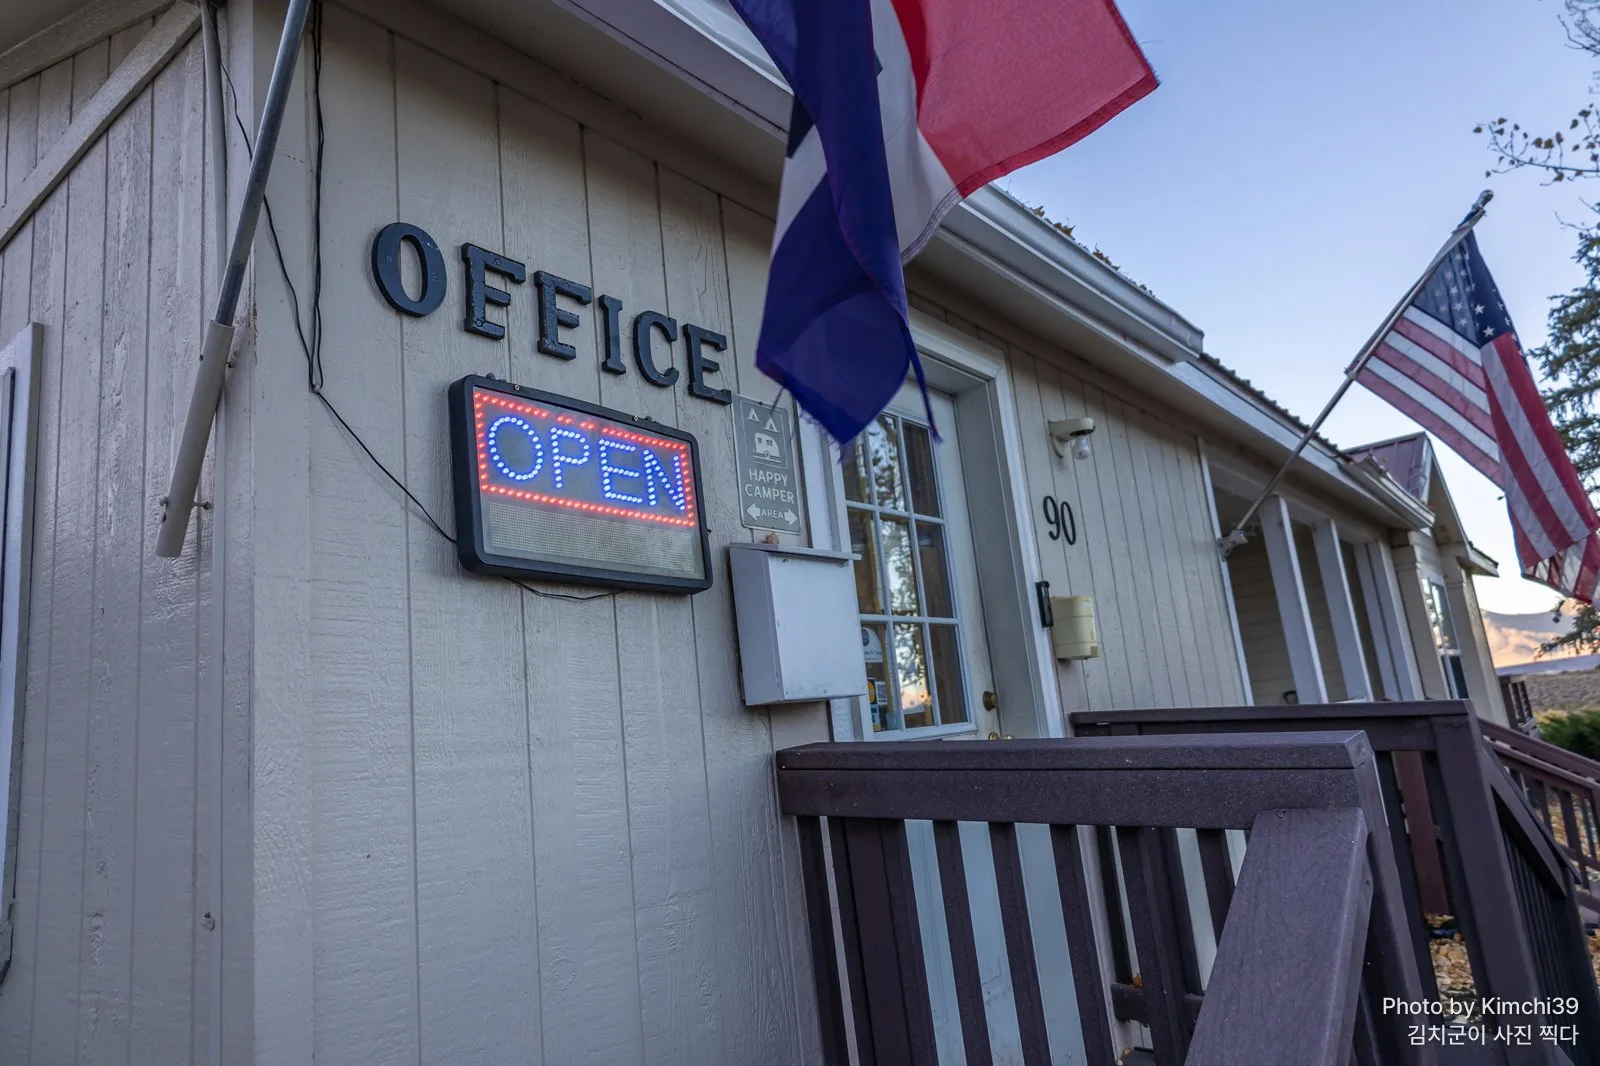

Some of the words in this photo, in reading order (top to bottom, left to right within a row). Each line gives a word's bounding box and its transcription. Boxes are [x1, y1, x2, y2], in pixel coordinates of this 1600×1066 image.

[371, 221, 732, 405] OFFICE
[487, 415, 687, 512] OPEN
[748, 467, 788, 487] HAPPY
[744, 484, 795, 504] CAMPER
[761, 508, 784, 520] AREA
[1042, 494, 1077, 546] 90
